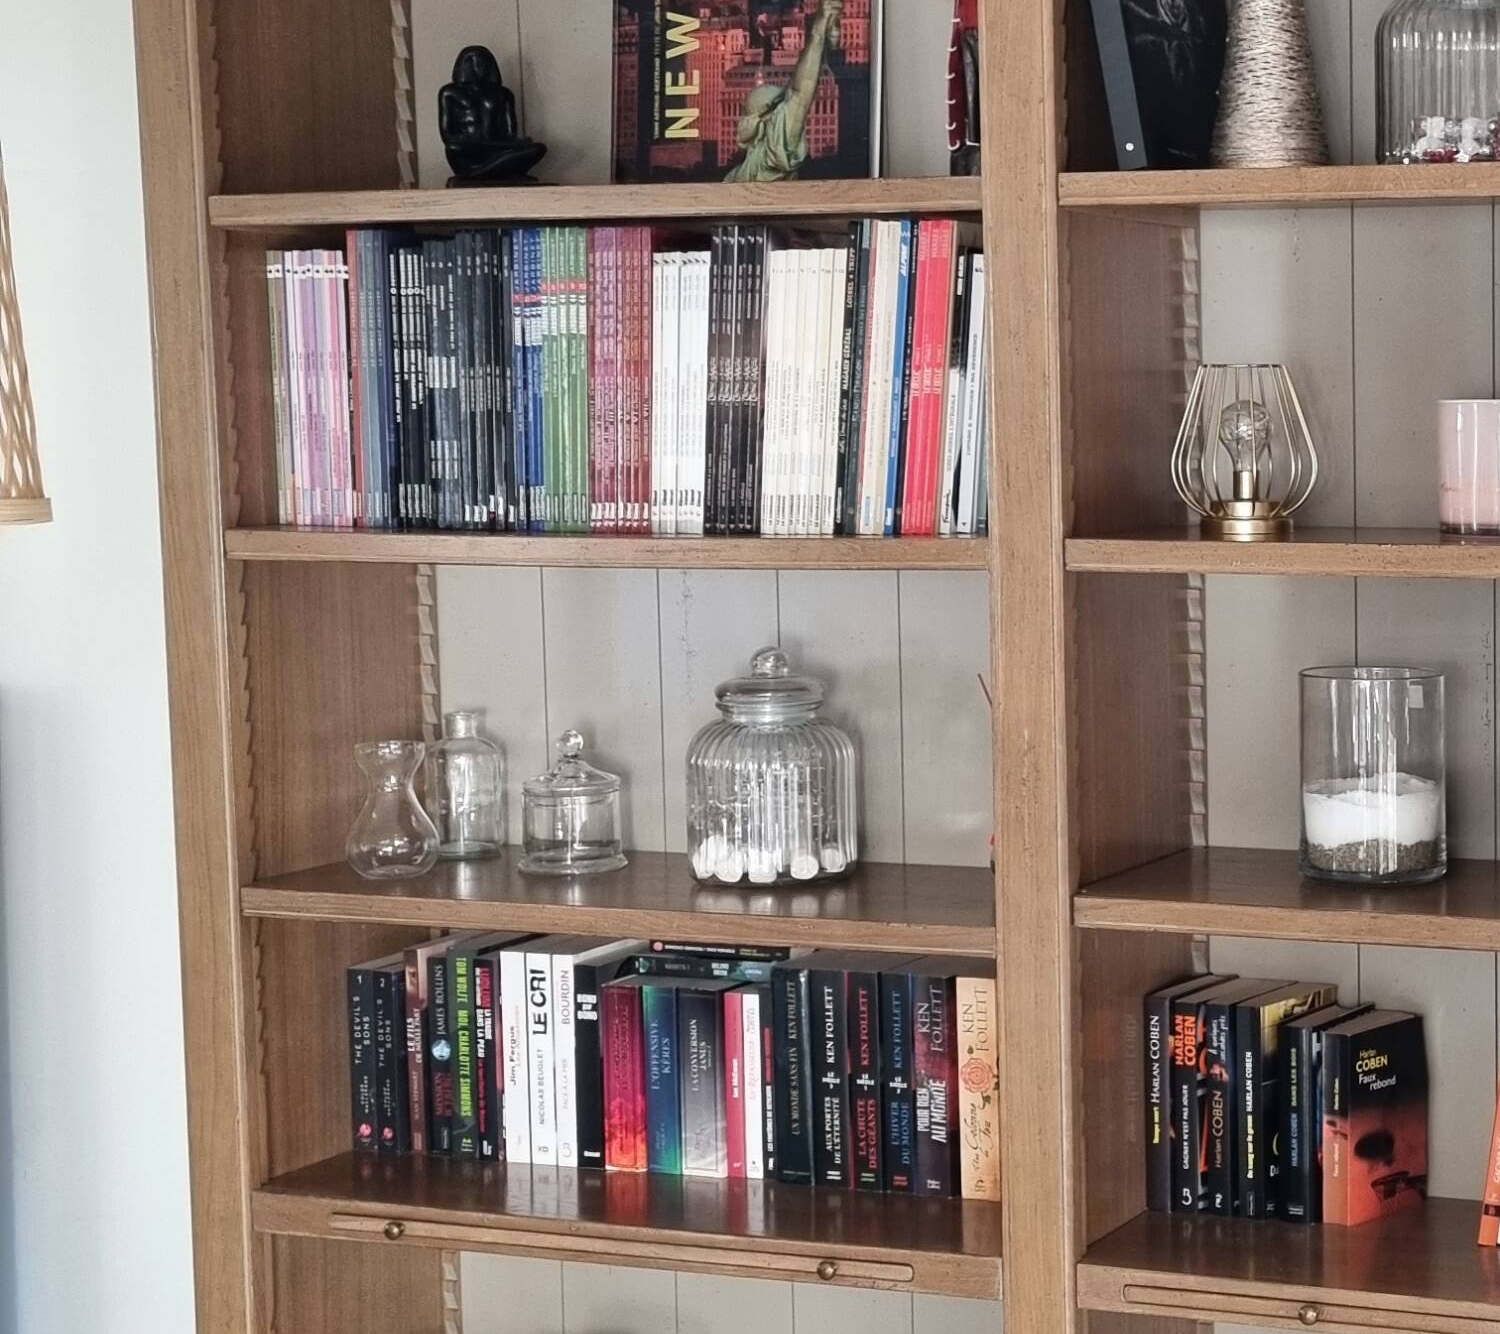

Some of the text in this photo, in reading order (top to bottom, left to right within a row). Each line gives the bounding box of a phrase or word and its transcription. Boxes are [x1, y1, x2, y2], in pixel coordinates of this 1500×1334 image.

[665, 12, 700, 139] NEW
[842, 359, 850, 390] MAGASIN
[456, 957, 467, 976] TOM
[434, 964, 446, 1035] JAMES ROLLINS
[456, 976, 468, 1003] WOLFE
[529, 969, 547, 1035] LE CRI
[560, 969, 571, 1025] BOURDIN
[353, 996, 362, 1039] DEVILS
[361, 1016, 371, 1046] SONS
[376, 999, 386, 1067] THE DEVILS
[384, 1019, 392, 1049] SONS
[406, 1018, 416, 1052] LE FILS
[476, 1009, 485, 1027] DANS
[477, 1028, 485, 1038] LA
[823, 985, 835, 1064] KEN FOLLETT
[859, 987, 870, 1067] KEN FOLLETT
[891, 990, 902, 1069] KEN FOLLETT
[917, 984, 944, 1052] KEN FOLLETT
[962, 986, 990, 1052] KEN FOLLETT
[1150, 1015, 1160, 1060] COBEN
[459, 1030, 471, 1076] CHARLOTTE
[477, 1039, 486, 1058] PEAU
[508, 1026, 517, 1086] Jim Fergus
[650, 1019, 660, 1090] L'OFFENSIVE
[689, 1019, 699, 1092] LA CONVERSION
[698, 1041, 707, 1071] JANUS
[786, 981, 800, 1136] UN MONDE SANS FIN KEN FOLLETT
[1175, 1015, 1184, 1066] HARLAN
[1184, 1015, 1197, 1066] COBEN
[536, 1049, 545, 1087] BEUGLET
[1150, 1062, 1161, 1103] HARLAN
[1245, 1051, 1253, 1078] COBEN
[1355, 1054, 1388, 1073] COBEN
[1358, 1073, 1377, 1085] Faux
[1369, 1075, 1396, 1091] rebond
[460, 1077, 472, 1117] SIMMONS
[916, 1088, 930, 1132] POUR RIEN
[929, 1078, 947, 1143] AU MONDE
[1181, 1084, 1189, 1106] JOUER
[1245, 1079, 1253, 1112] HARLAN
[824, 1096, 833, 1152] AUX PORTES
[831, 1097, 842, 1164] DE L'ÉTERNITÉ
[857, 1098, 867, 1156] LA CHUTE
[866, 1098, 877, 1169] DES GÉANTS
[890, 1101, 900, 1145] L'HIVER
[900, 1101, 911, 1165] DU MONDE
[1212, 1090, 1224, 1168] Harlan COBEN
[1182, 1141, 1190, 1170] GAGNER
